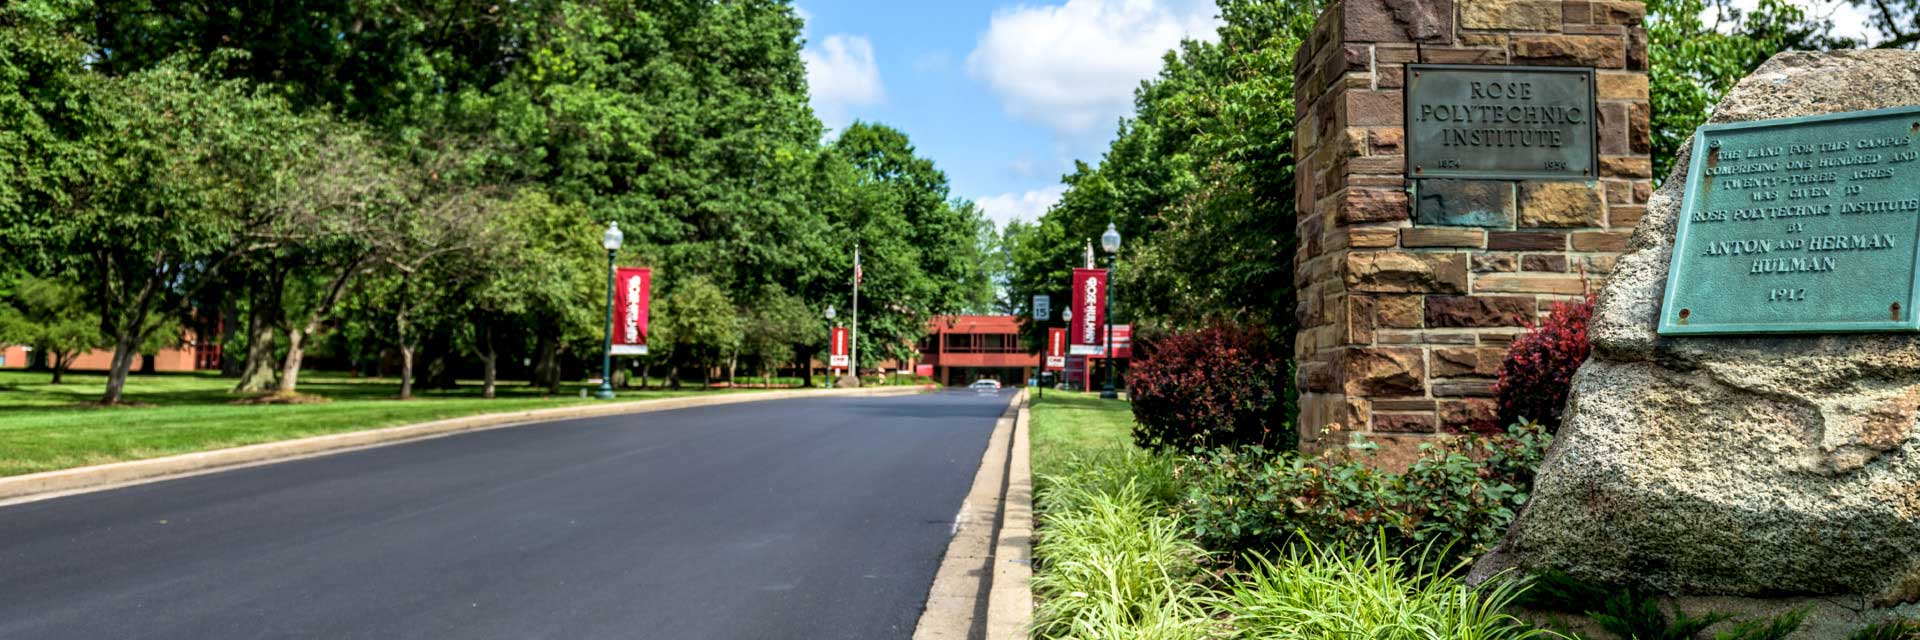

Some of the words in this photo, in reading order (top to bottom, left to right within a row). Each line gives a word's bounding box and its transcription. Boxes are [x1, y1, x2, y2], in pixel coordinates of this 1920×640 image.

[1471, 82, 1532, 100] ROSE
[1442, 129, 1561, 148] INSTITUTE
[1717, 149, 1741, 161] THE
[1747, 146, 1783, 158] LAND
[1790, 143, 1815, 156] FOR
[1819, 140, 1850, 153] THIS
[1857, 135, 1912, 149] CAMPUS
[1705, 163, 1778, 177] COMPRISING
[1786, 160, 1813, 170] ONE
[1818, 154, 1882, 168] HUNDRED
[1889, 151, 1919, 163] AND
[1723, 172, 1837, 190] TWENTY-THREE
[1849, 168, 1895, 181] ACRES
[1752, 190, 1779, 201] WAS
[1789, 187, 1831, 199] GIVEN
[1846, 185, 1862, 194] TO
[1691, 210, 1728, 222] ROSE
[1732, 204, 1832, 221] POLYTECHNIC
[1840, 199, 1919, 214] INSTITUTE
[1786, 223, 1805, 233] BY
[1703, 240, 1773, 256] ANTON
[1775, 240, 1804, 250] AND
[1808, 234, 1896, 251] HERMAN
[1750, 257, 1837, 274] HULMAN
[1768, 288, 1806, 301] 1917
[1036, 308, 1047, 317] 15
